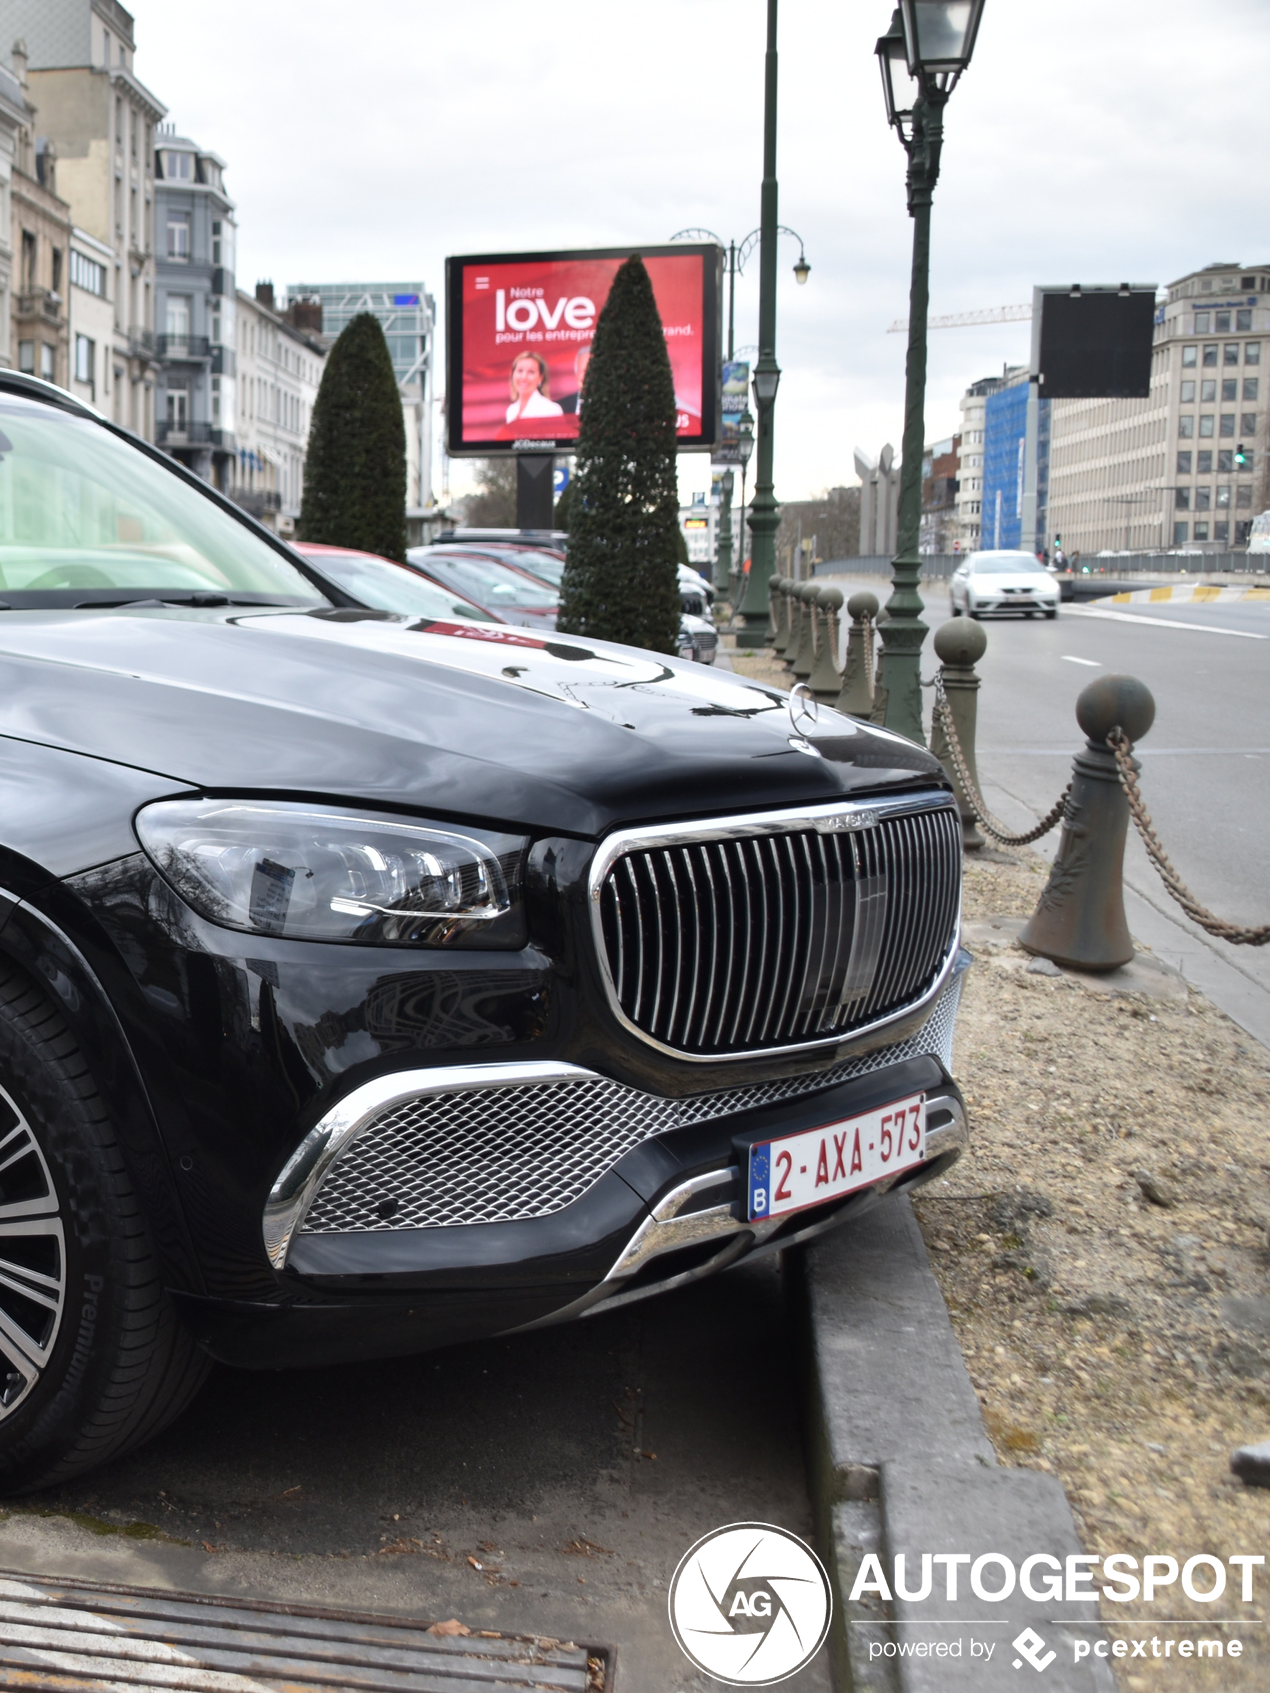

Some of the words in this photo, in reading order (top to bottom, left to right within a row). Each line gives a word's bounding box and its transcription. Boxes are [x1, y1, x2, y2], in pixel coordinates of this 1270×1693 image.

[510, 287, 544, 298] Notre
[495, 288, 596, 331] love
[495, 332, 524, 345] pour
[526, 331, 543, 342] les
[545, 329, 596, 342] entrepre
[662, 323, 694, 337] rand.
[774, 1103, 921, 1201] 2-AXA-573
[753, 1187, 767, 1212] B
